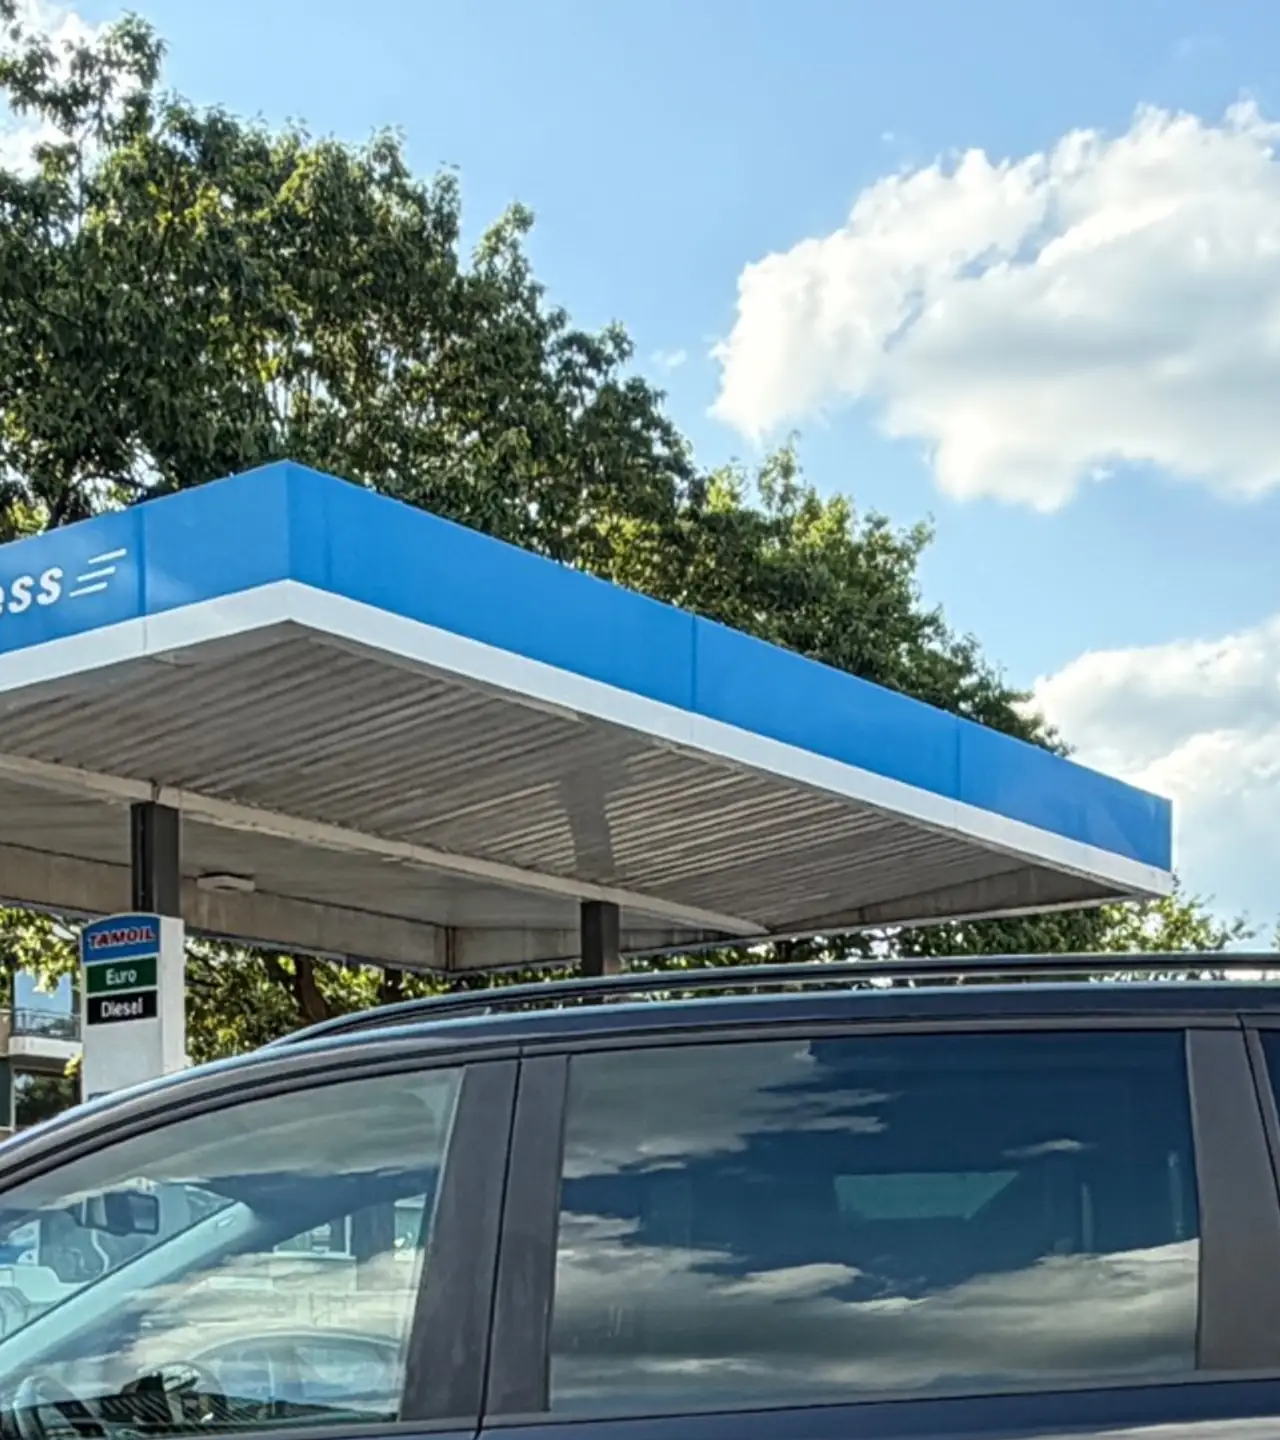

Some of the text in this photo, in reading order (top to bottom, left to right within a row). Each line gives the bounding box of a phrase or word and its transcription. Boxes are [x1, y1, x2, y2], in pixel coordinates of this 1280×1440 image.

[88, 925, 156, 950] TAMOIL
[105, 968, 137, 985] Euro
[101, 997, 143, 1018] Diesel
